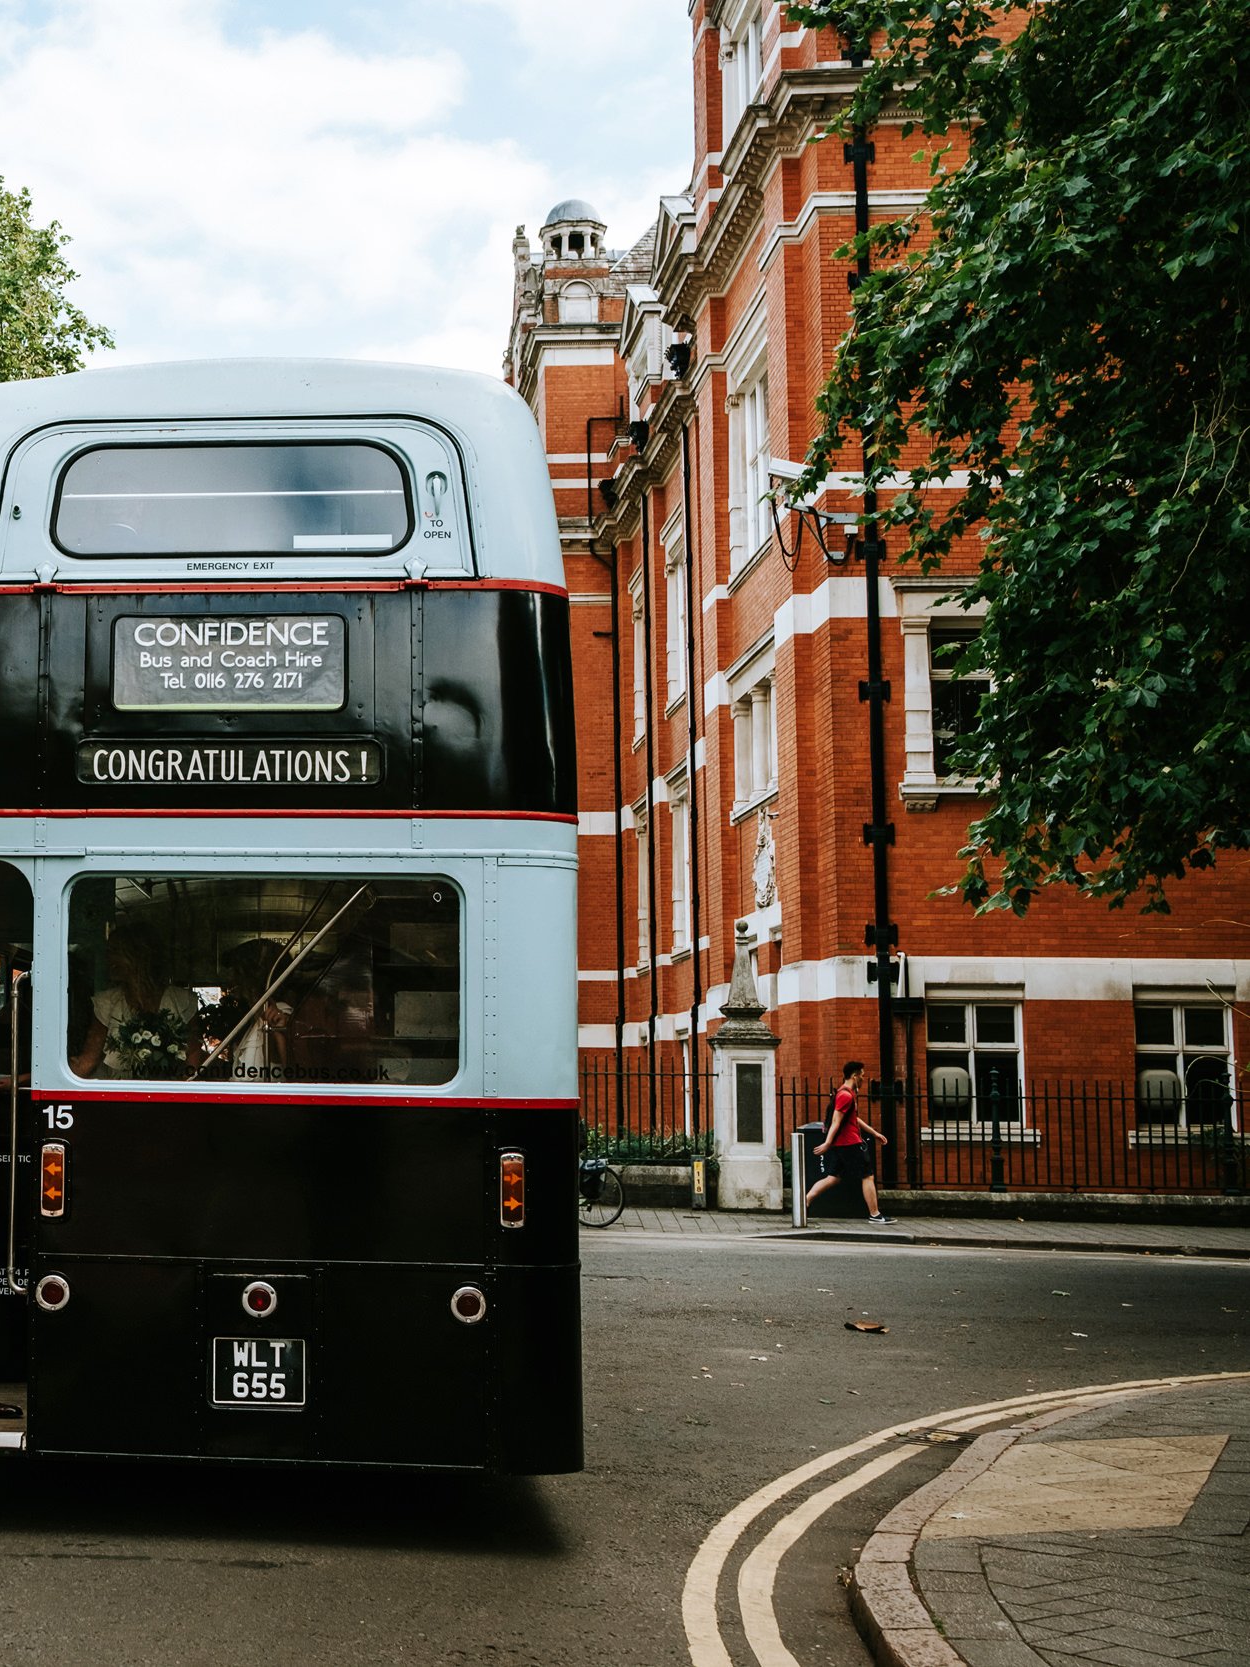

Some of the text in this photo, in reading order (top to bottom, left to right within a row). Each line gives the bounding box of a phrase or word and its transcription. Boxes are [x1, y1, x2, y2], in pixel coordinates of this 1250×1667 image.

[429, 519, 444, 528] TO
[423, 530, 452, 539] OPEN
[186, 561, 275, 571] EMERGENCY EXIT
[133, 621, 330, 647] CONFIDENCE
[139, 650, 323, 668] Bus and Coach Hire
[160, 671, 303, 689] Tel 0116 276 2171
[42, 1104, 74, 1130] 15
[233, 1341, 286, 1368] WLT
[232, 1372, 286, 1399] 655
